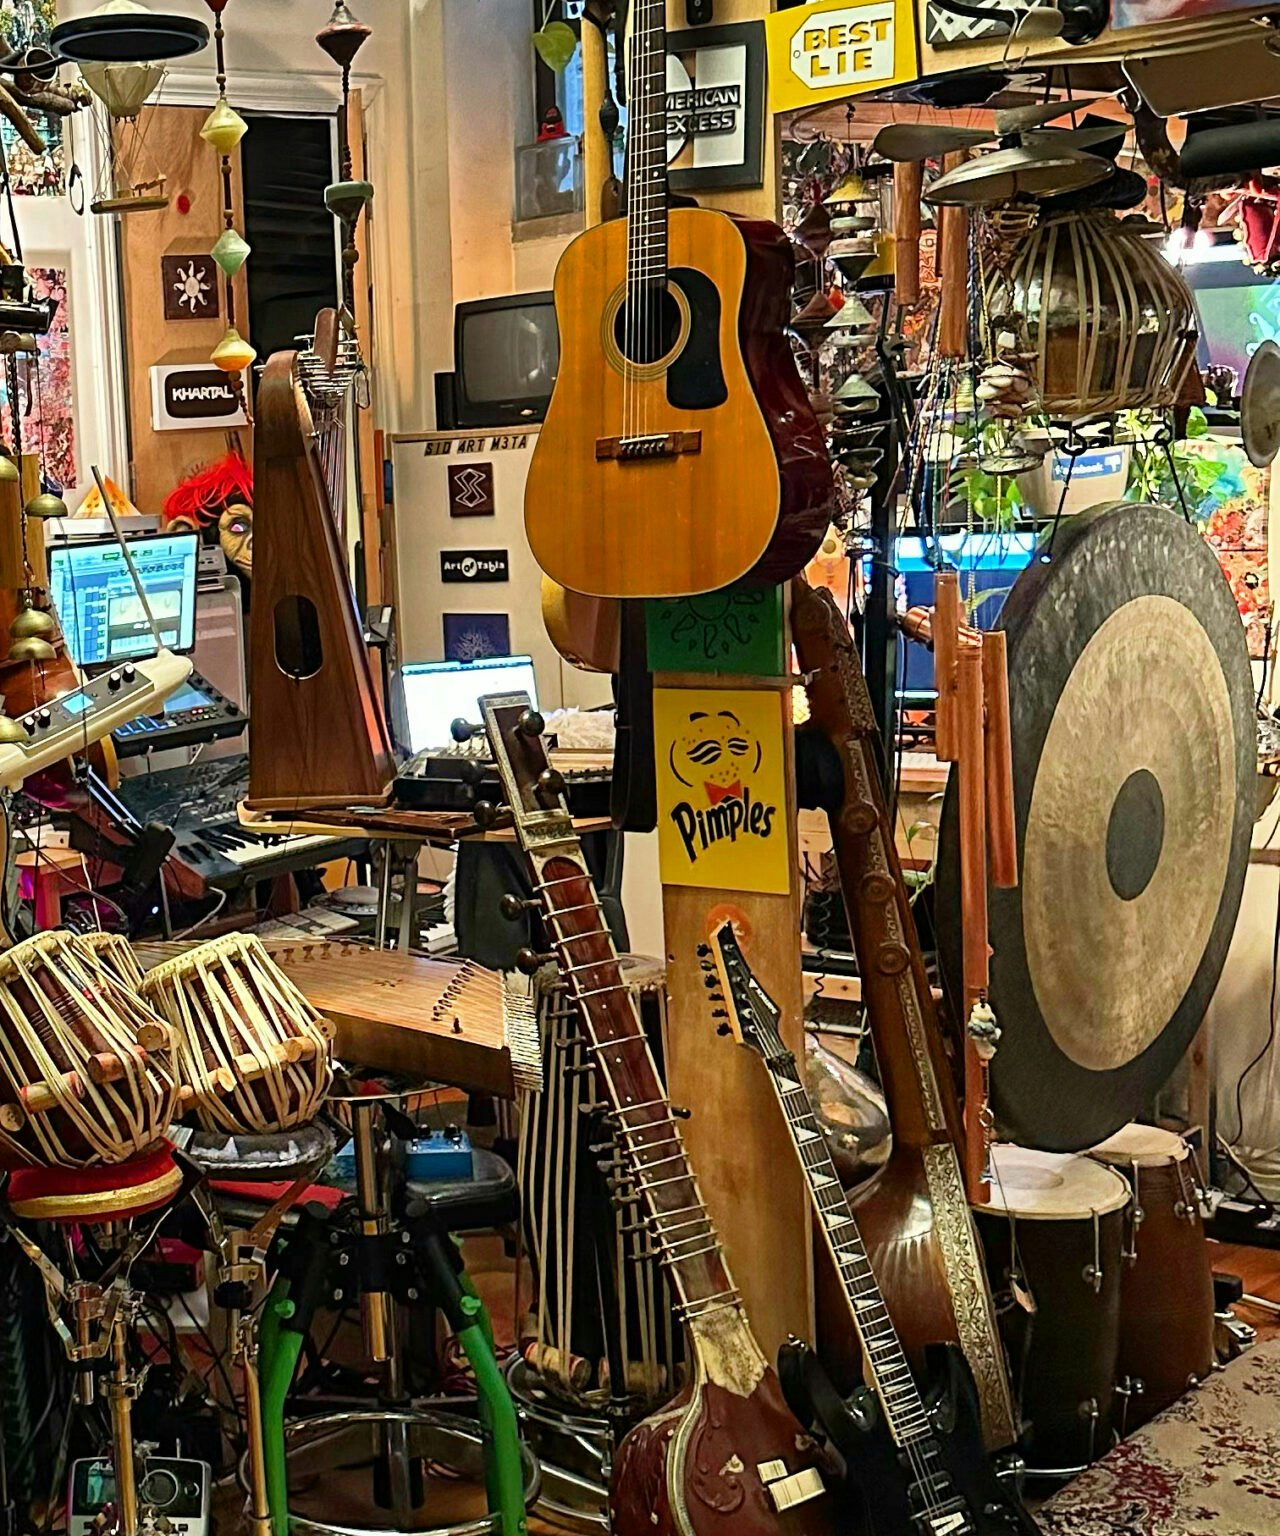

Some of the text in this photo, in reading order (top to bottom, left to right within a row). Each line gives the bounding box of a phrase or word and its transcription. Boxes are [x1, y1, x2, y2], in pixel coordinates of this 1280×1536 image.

[804, 17, 892, 52] BEST
[811, 47, 872, 78] LIE
[666, 87, 739, 110] MERICAN
[172, 385, 234, 401] KHARTAL
[444, 561, 461, 571] Art
[476, 560, 505, 573] Tabla
[671, 787, 776, 863] Pimples
